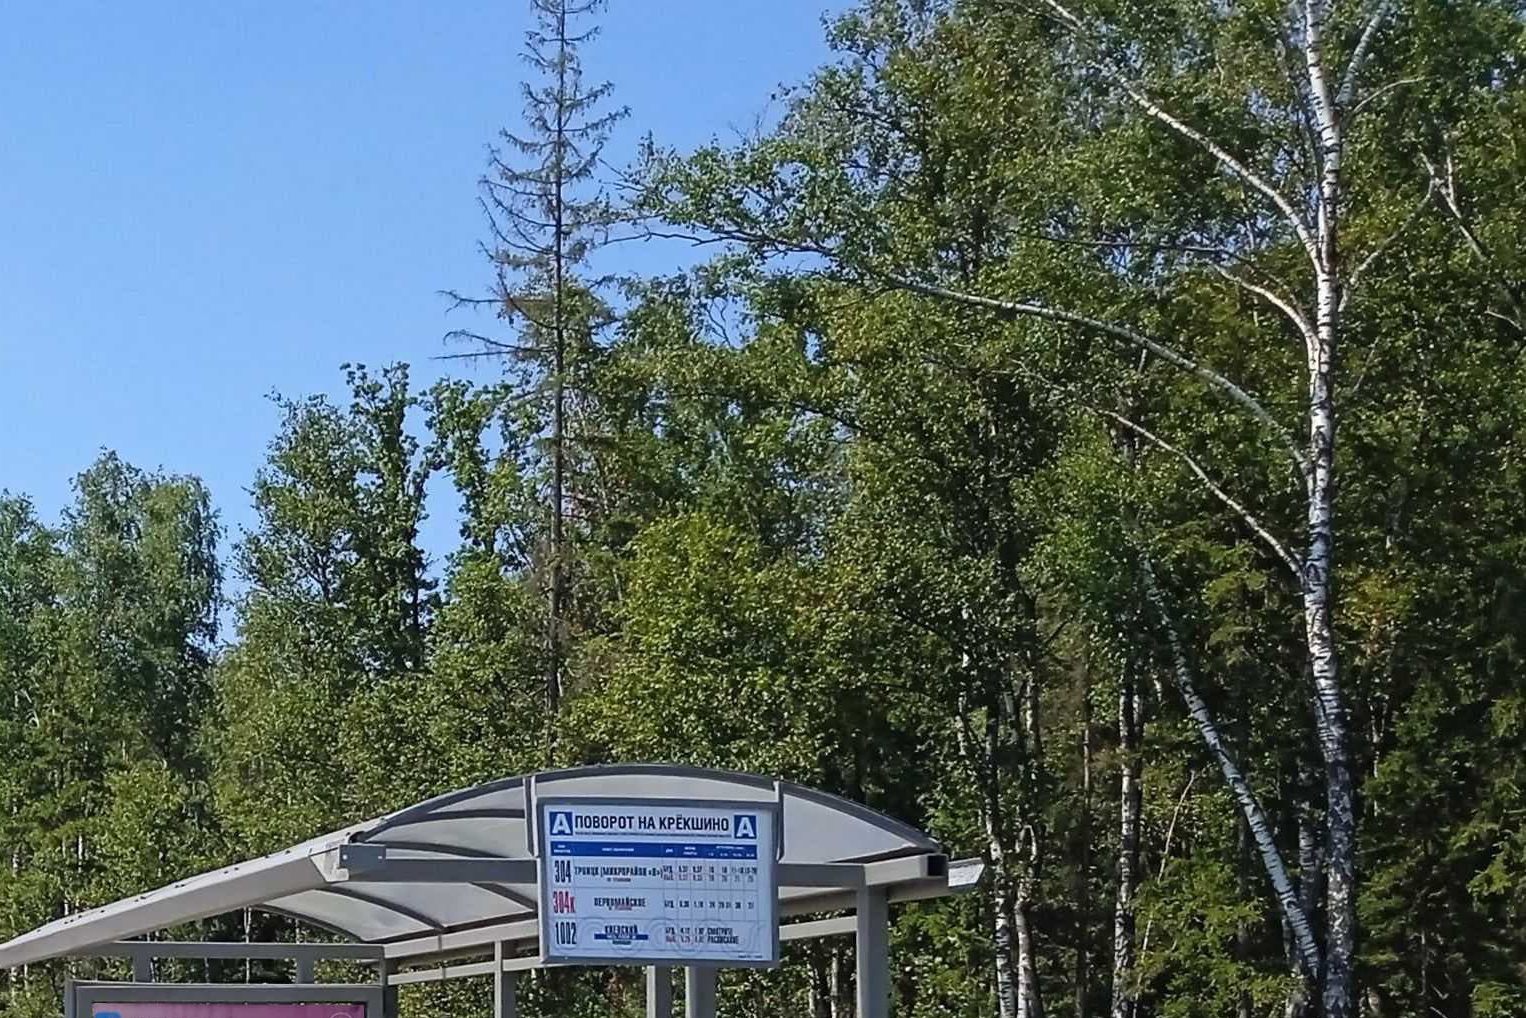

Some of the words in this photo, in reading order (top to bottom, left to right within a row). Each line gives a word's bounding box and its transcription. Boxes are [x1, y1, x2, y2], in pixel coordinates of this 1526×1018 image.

[574, 815, 635, 829] ПОВОРОТ
[638, 816, 656, 830] НА
[659, 814, 729, 831] КРЁКШИНО
[554, 860, 572, 883] 304
[555, 922, 577, 945] 1002
